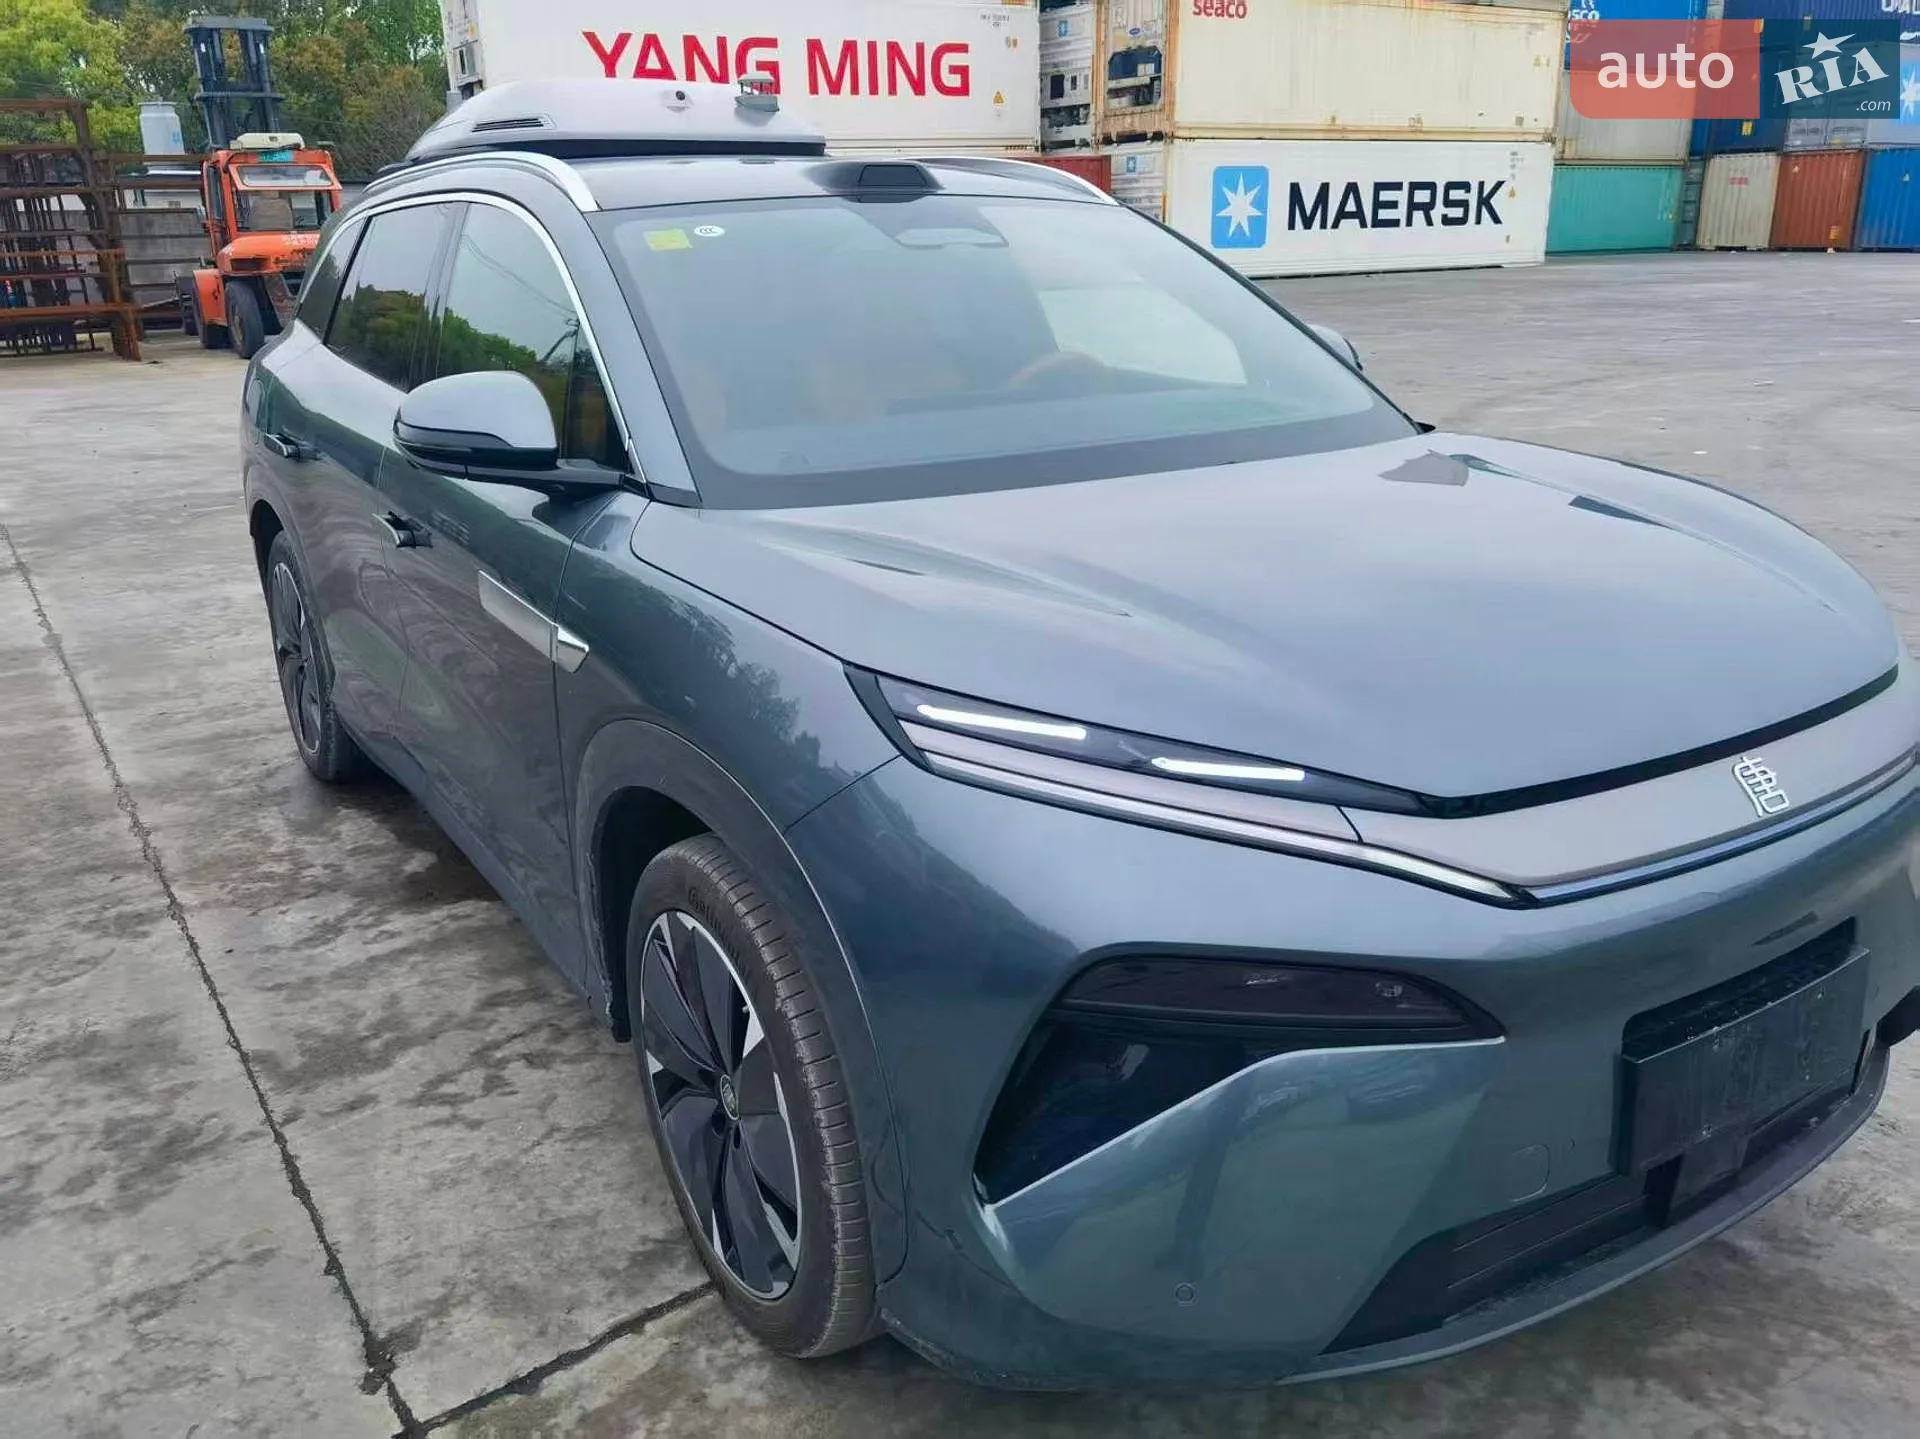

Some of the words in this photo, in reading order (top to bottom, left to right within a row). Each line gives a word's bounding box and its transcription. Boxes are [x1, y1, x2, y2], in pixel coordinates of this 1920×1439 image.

[582, 31, 781, 95] YANG
[806, 38, 970, 97] MING
[1288, 180, 1506, 231] MAERSK
